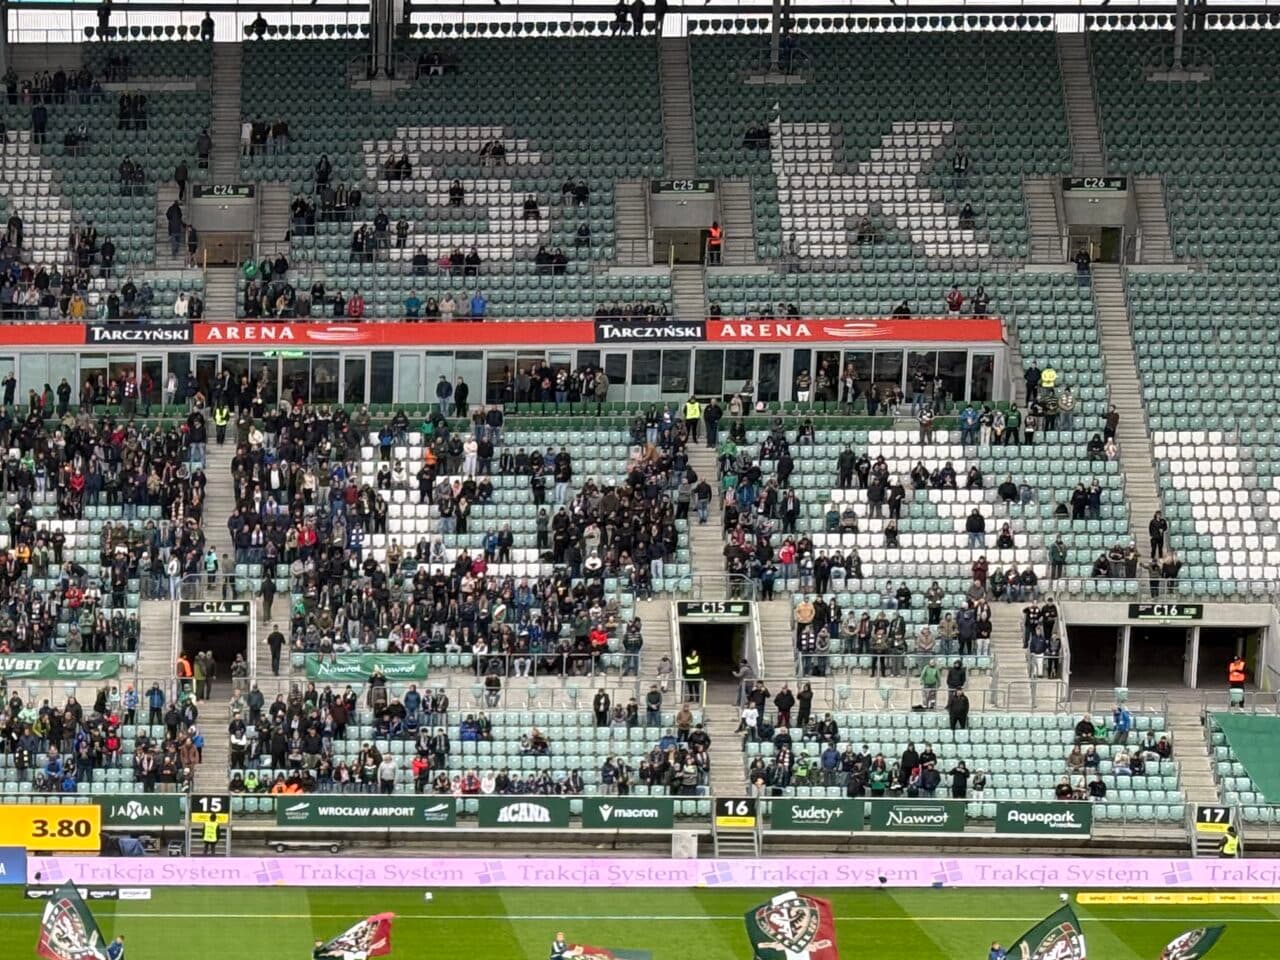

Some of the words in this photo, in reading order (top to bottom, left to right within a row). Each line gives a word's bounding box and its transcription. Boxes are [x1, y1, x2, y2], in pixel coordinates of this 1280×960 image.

[673, 180, 693, 190] C25
[1084, 178, 1105, 187] C26
[214, 185, 234, 195] C24
[207, 327, 294, 339] ARENA
[720, 324, 812, 337] ARENA
[203, 602, 226, 612] C14
[702, 602, 725, 613] C15
[1154, 604, 1178, 615] C16
[57, 658, 104, 671] LVBET
[110, 800, 163, 819] JAXAN
[199, 797, 222, 812] 15
[371, 807, 415, 816] AIRPORT
[724, 800, 748, 815] 16
[614, 809, 659, 818] macron
[886, 811, 949, 826] Nawrot
[1007, 810, 1074, 824] Aquapark
[1203, 808, 1225, 823] 17
[32, 819, 91, 838] 3.80
[74, 863, 154, 881] Trakcja
[295, 864, 376, 882] Trakcja
[518, 865, 600, 883] Trakcja
[745, 865, 828, 883] Trakcja
[975, 864, 1058, 883] Trakcja
